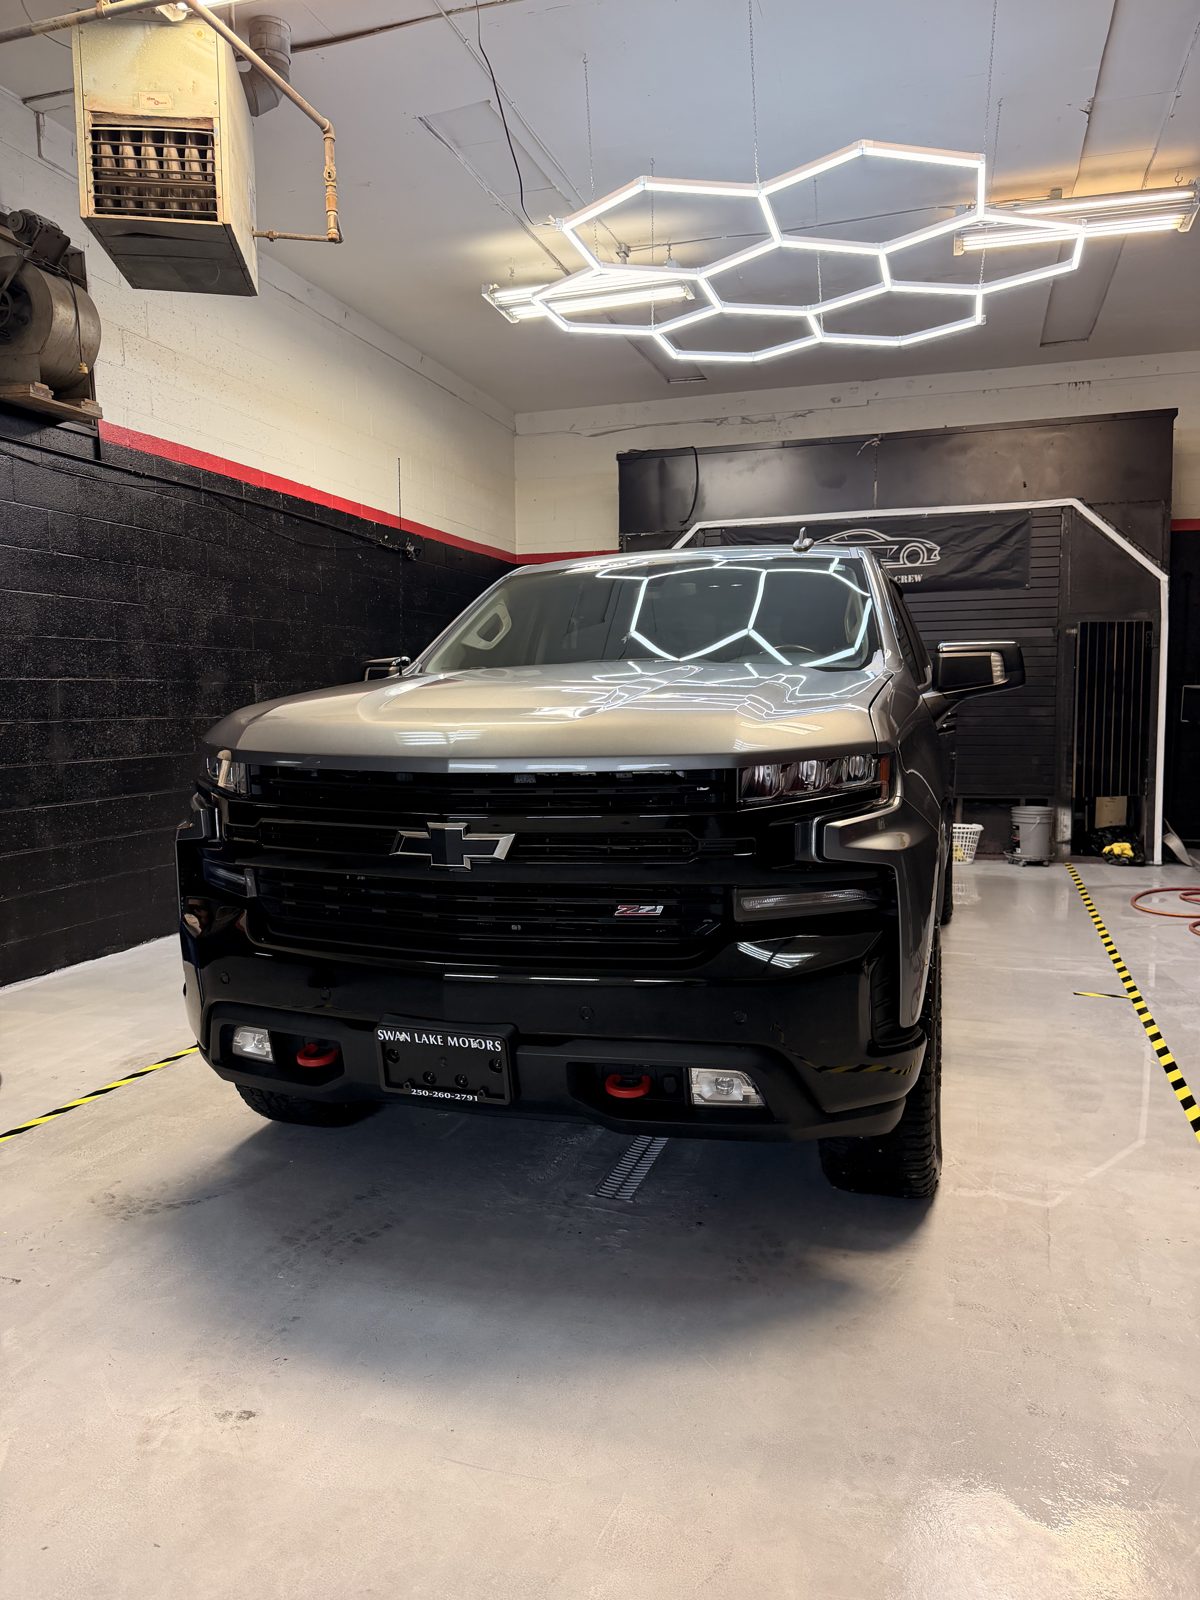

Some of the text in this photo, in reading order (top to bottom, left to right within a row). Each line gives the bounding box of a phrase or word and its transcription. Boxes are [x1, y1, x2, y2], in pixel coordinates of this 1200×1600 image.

[894, 574, 923, 584] CREW
[377, 1029, 502, 1052] SWAN LAKE MOTORS
[411, 1088, 479, 1102] 250-260-2791
